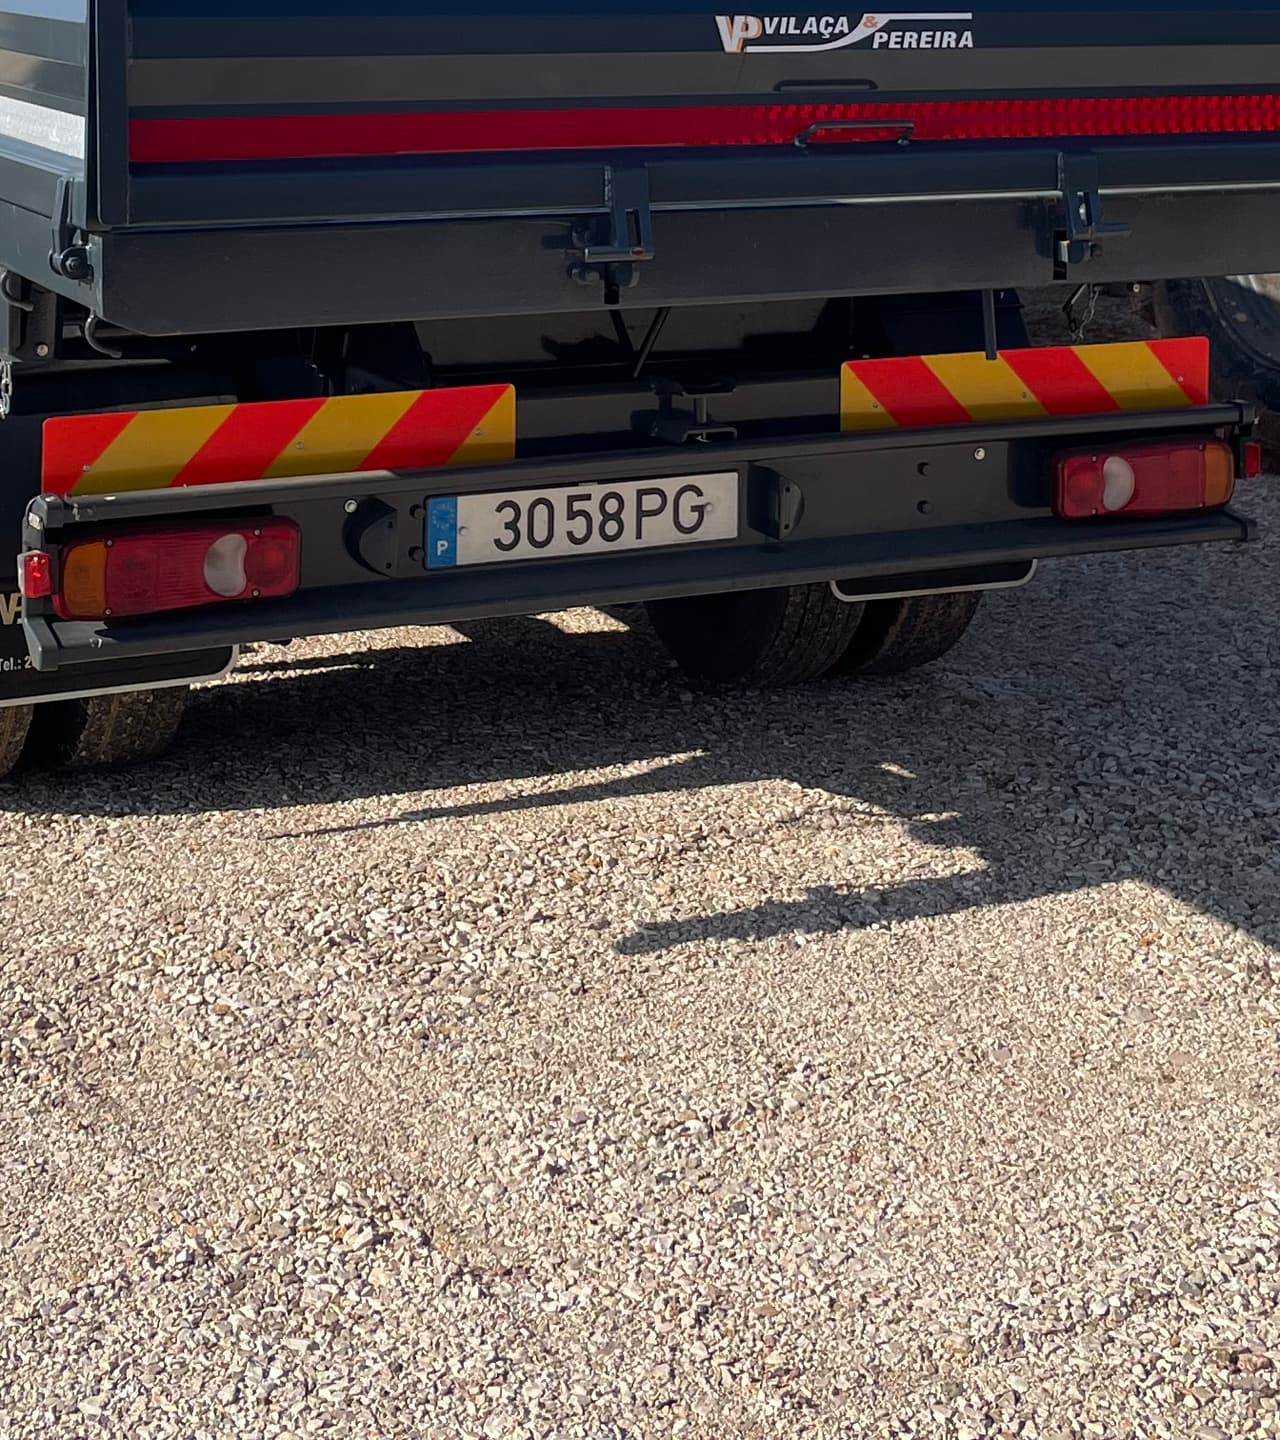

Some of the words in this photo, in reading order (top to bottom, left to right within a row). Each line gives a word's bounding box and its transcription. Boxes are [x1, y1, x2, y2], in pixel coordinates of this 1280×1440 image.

[763, 16, 850, 39] VILAÇA
[872, 31, 974, 49] PEREIRA
[436, 540, 449, 557] P
